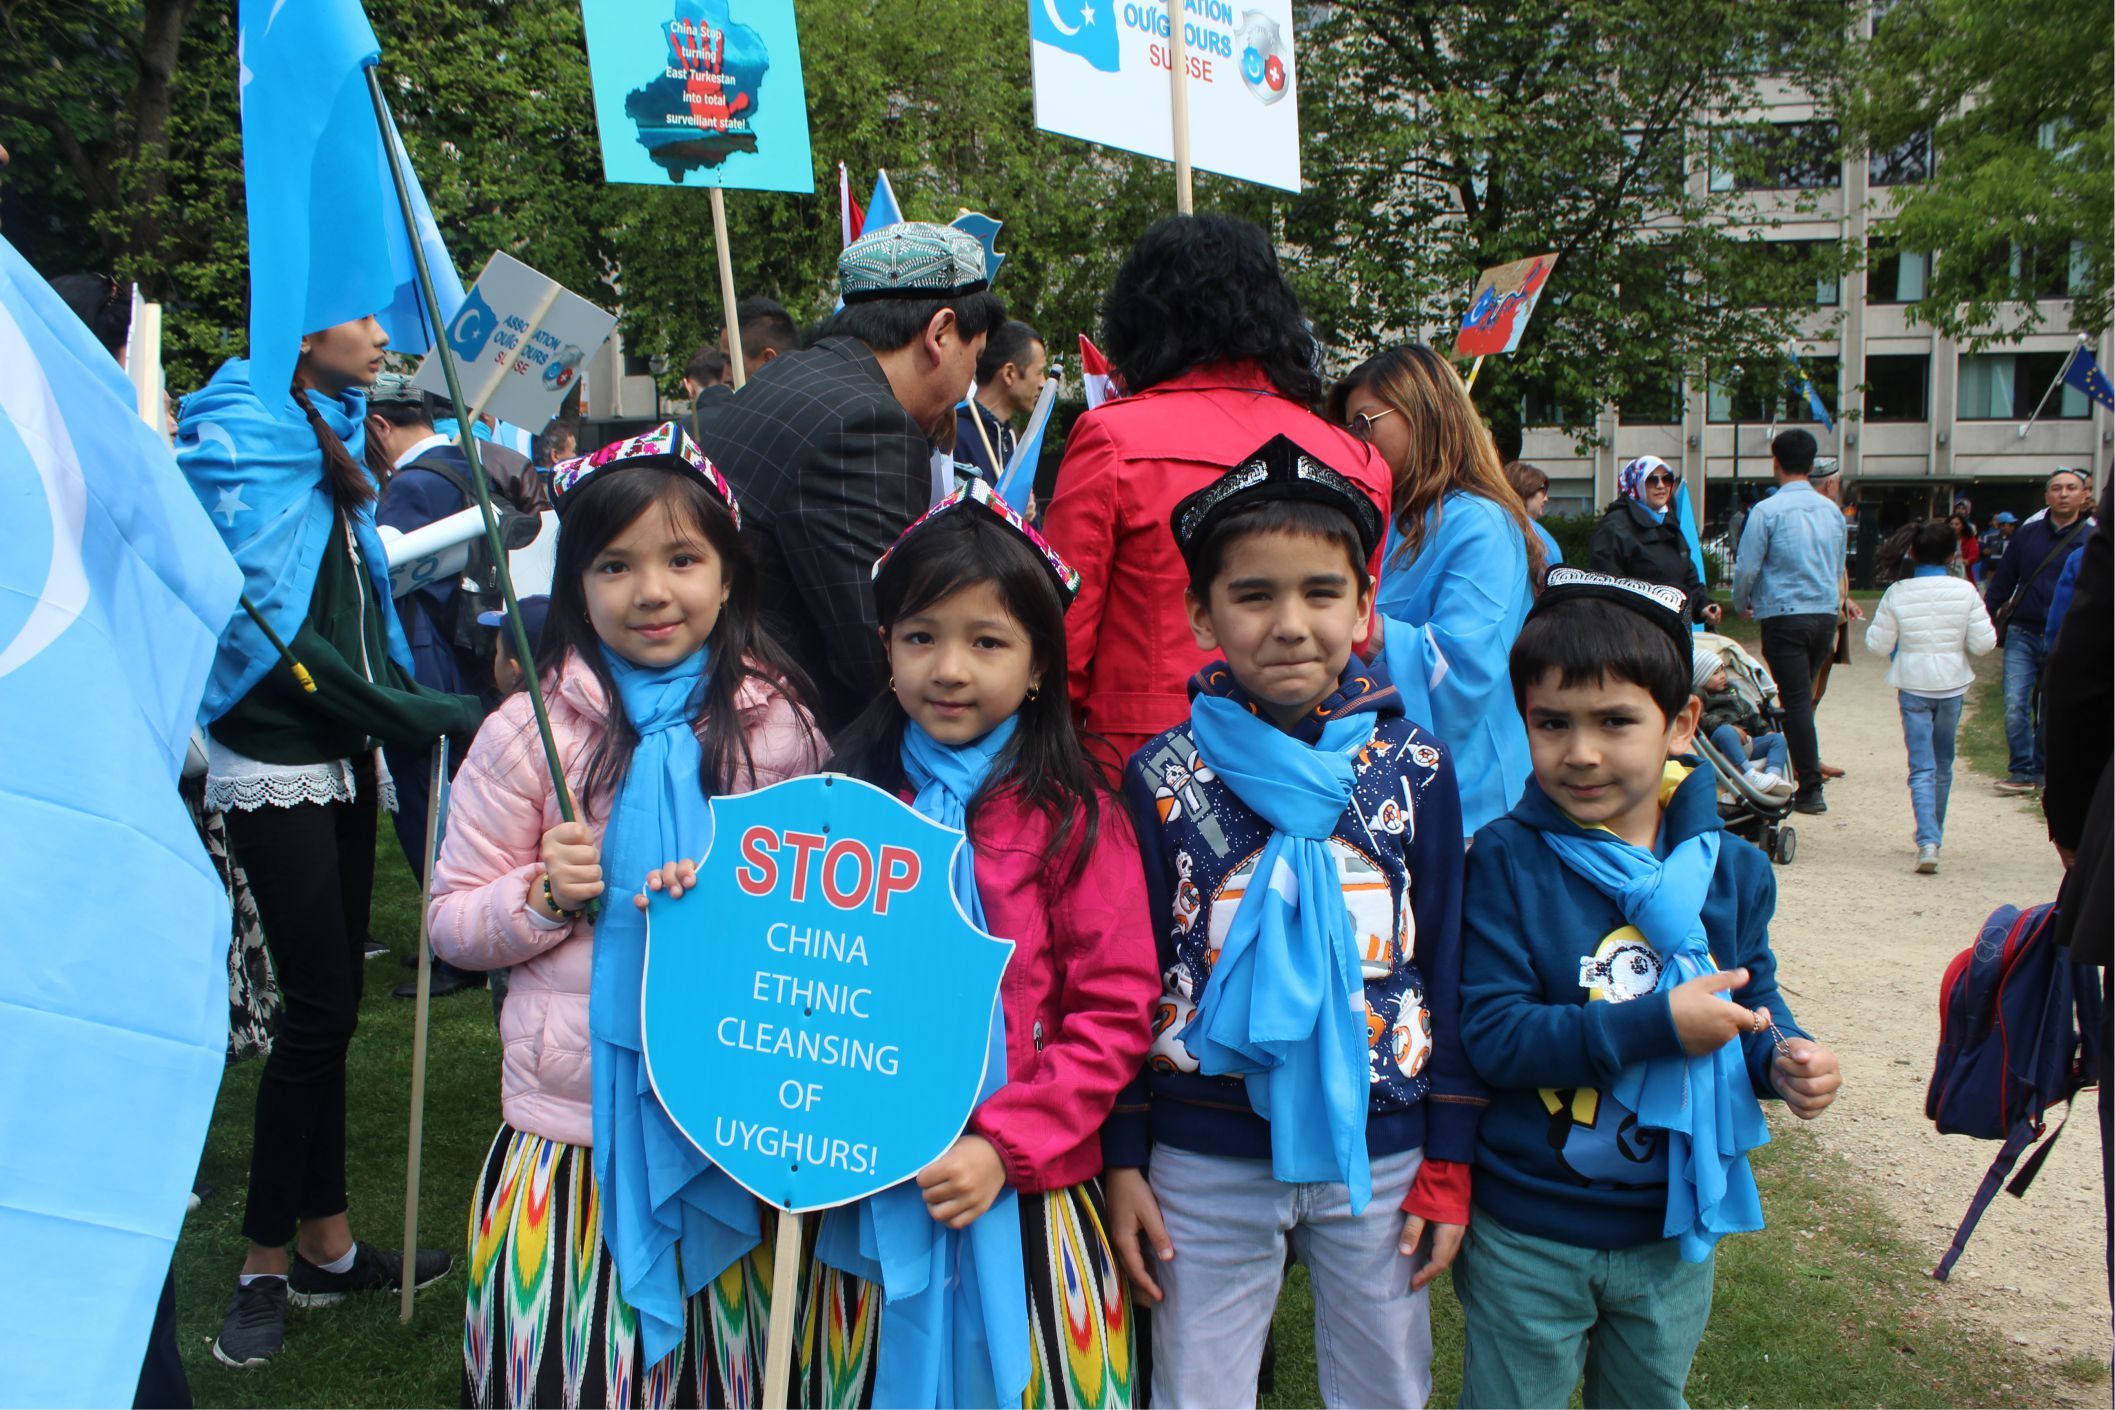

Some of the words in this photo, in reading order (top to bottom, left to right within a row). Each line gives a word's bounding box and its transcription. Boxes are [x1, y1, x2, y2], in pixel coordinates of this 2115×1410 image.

[670, 21, 698, 36] China
[700, 26, 722, 40] Stop
[1123, 3, 1233, 58] OUÏGOURS
[681, 46, 717, 63] turning
[1149, 43, 1213, 83] SUSE
[665, 66, 687, 80] East
[689, 69, 736, 85] Turkestan
[682, 90, 702, 103] into
[704, 93, 726, 106] total
[666, 113, 717, 128] surveillant
[719, 117, 746, 130] state!
[494, 330, 549, 365] OUÏGOURS
[503, 314, 561, 351] ASSOATION
[735, 825, 921, 916] STOP
[766, 922, 869, 966] CHINA
[753, 971, 872, 1018] ETHNIC
[717, 1016, 899, 1075] CLEANSING
[778, 1080, 823, 1112] OF
[715, 1117, 879, 1176] UYGHURS!
